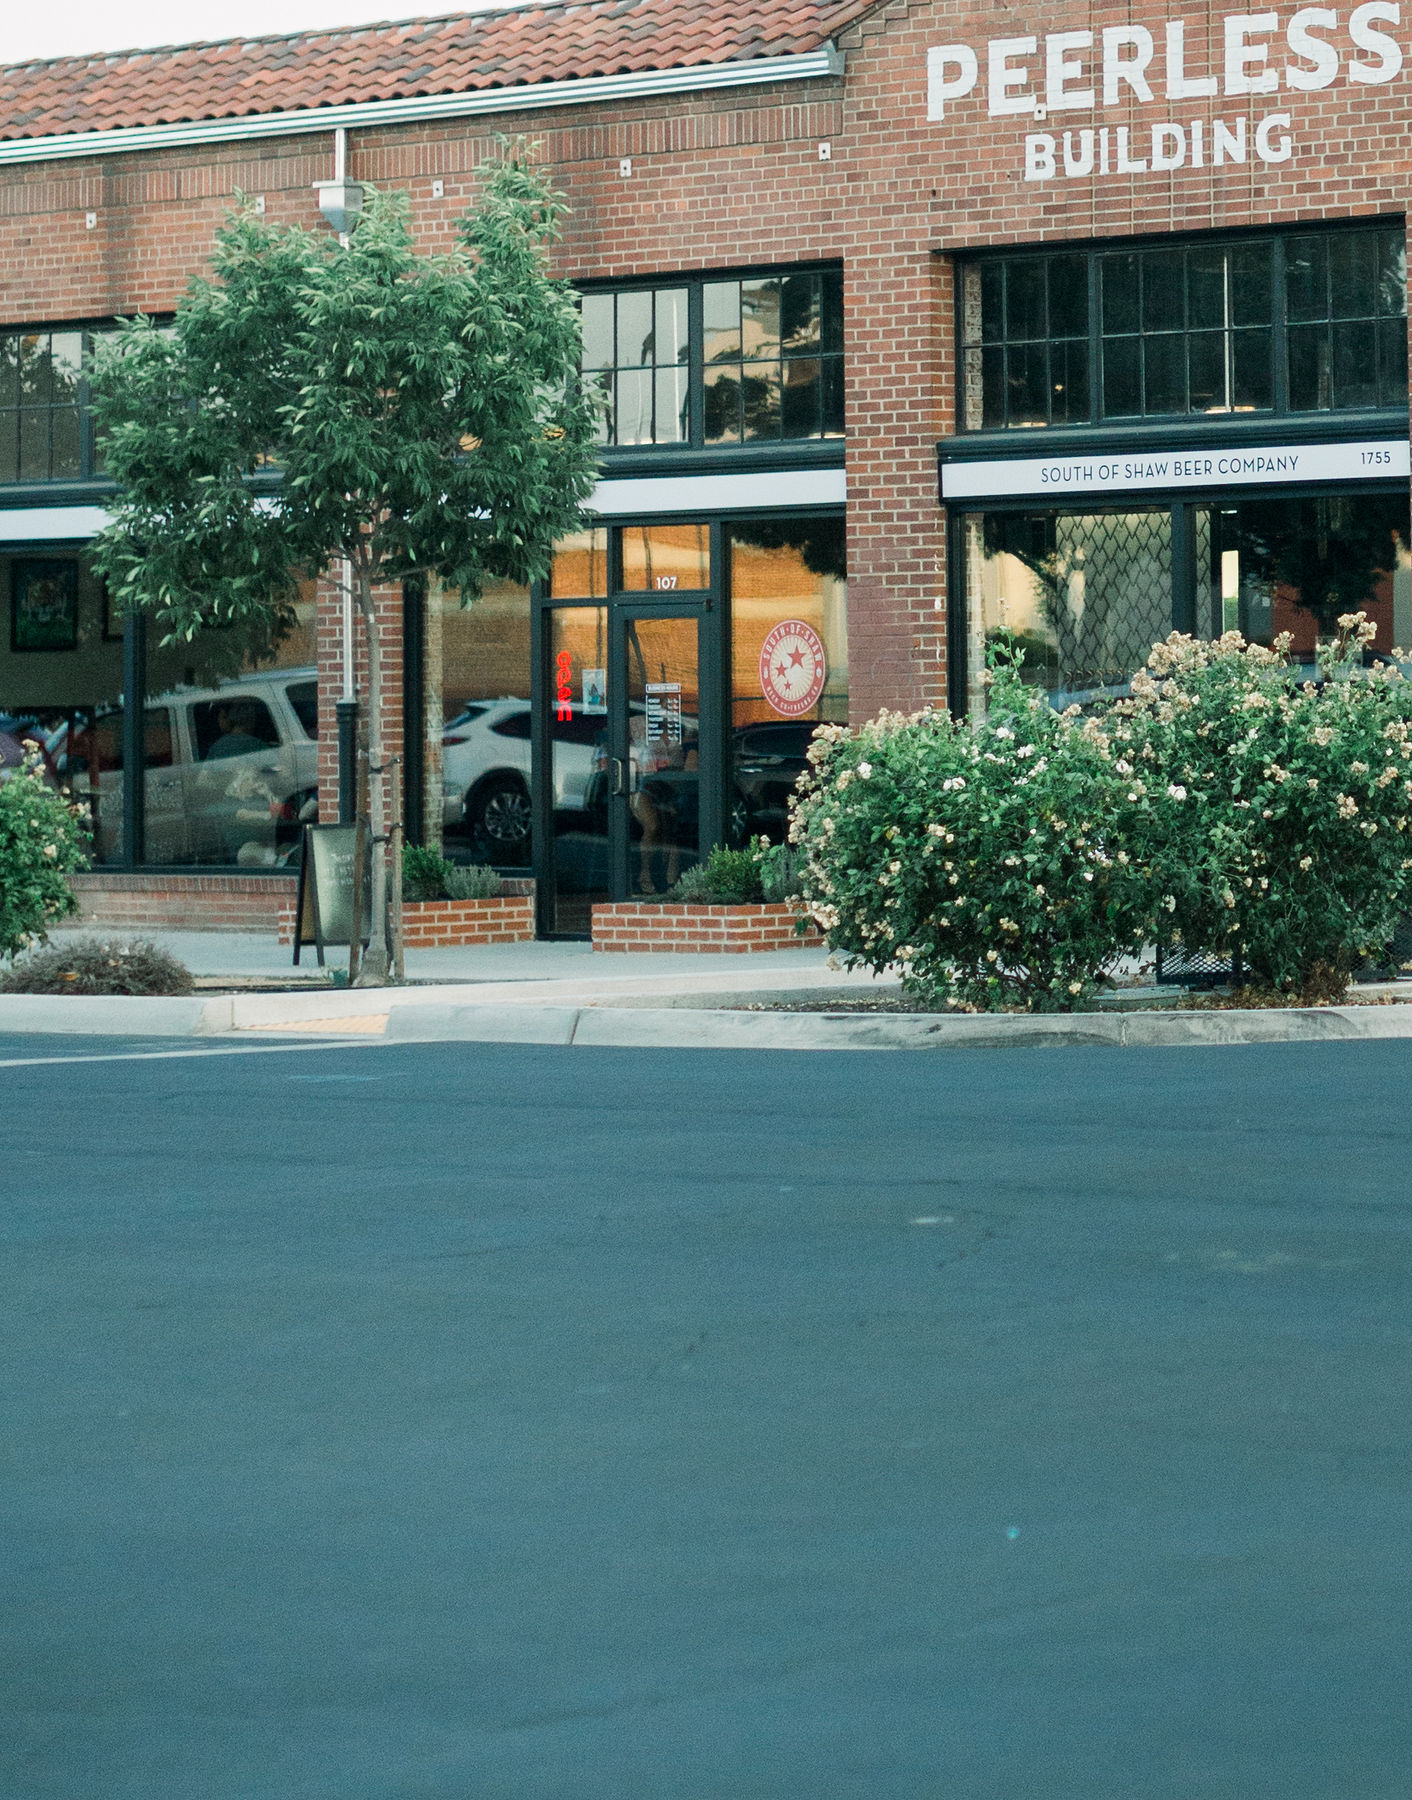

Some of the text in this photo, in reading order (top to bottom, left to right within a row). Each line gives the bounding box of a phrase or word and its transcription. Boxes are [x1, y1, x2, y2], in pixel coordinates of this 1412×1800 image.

[927, 1, 1403, 121] PEERLESS
[1024, 113, 1292, 182] BUILDING
[1041, 455, 1299, 483] SOUTH OF SHAW BEER COMPANY
[1361, 451, 1391, 464] 1755
[656, 576, 677, 589] 107
[763, 623, 822, 661] SOUTH OF SHAW
